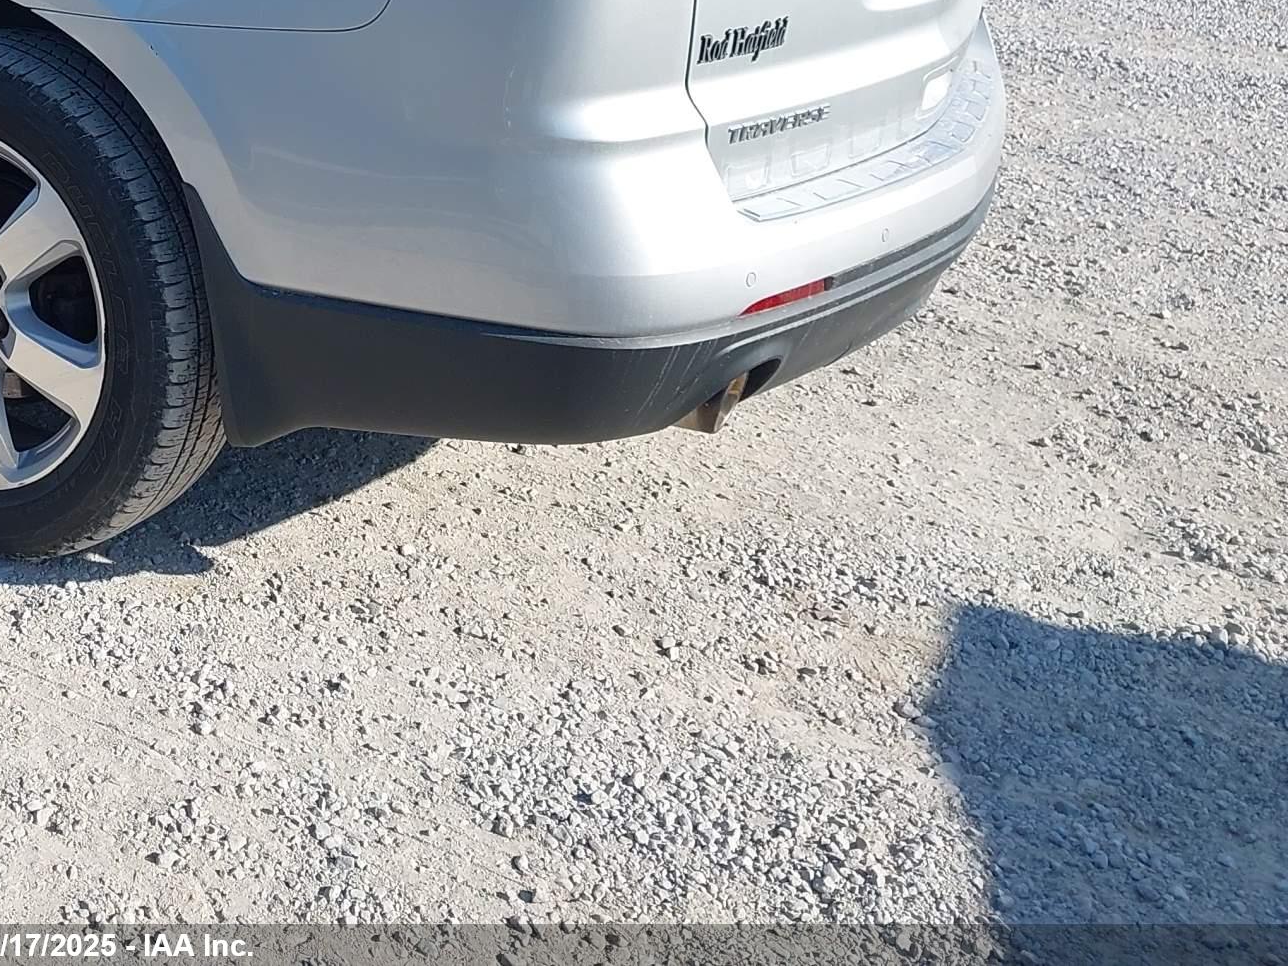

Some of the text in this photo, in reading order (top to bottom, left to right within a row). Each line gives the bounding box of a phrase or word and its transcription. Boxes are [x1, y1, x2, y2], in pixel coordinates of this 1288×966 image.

[697, 15, 789, 64] Rod Hatfield
[727, 105, 831, 144] TRAVERSE
